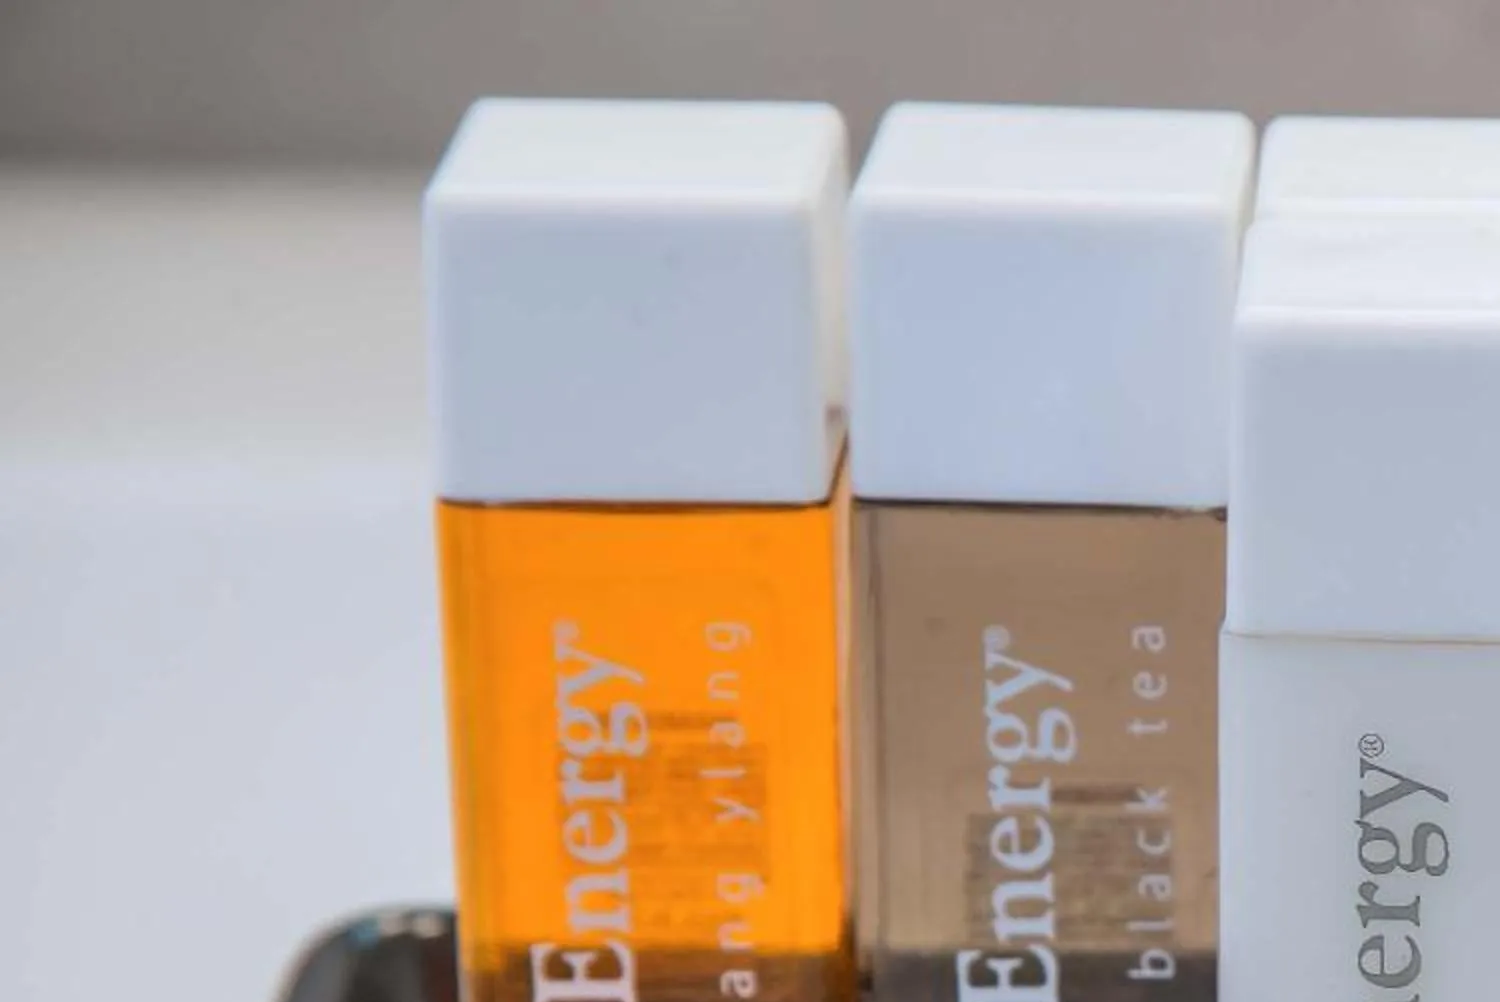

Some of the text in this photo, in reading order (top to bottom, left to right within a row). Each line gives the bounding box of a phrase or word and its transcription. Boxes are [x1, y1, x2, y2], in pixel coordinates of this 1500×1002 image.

[700, 619, 762, 824] ylang
[1127, 623, 1177, 981] black tea
